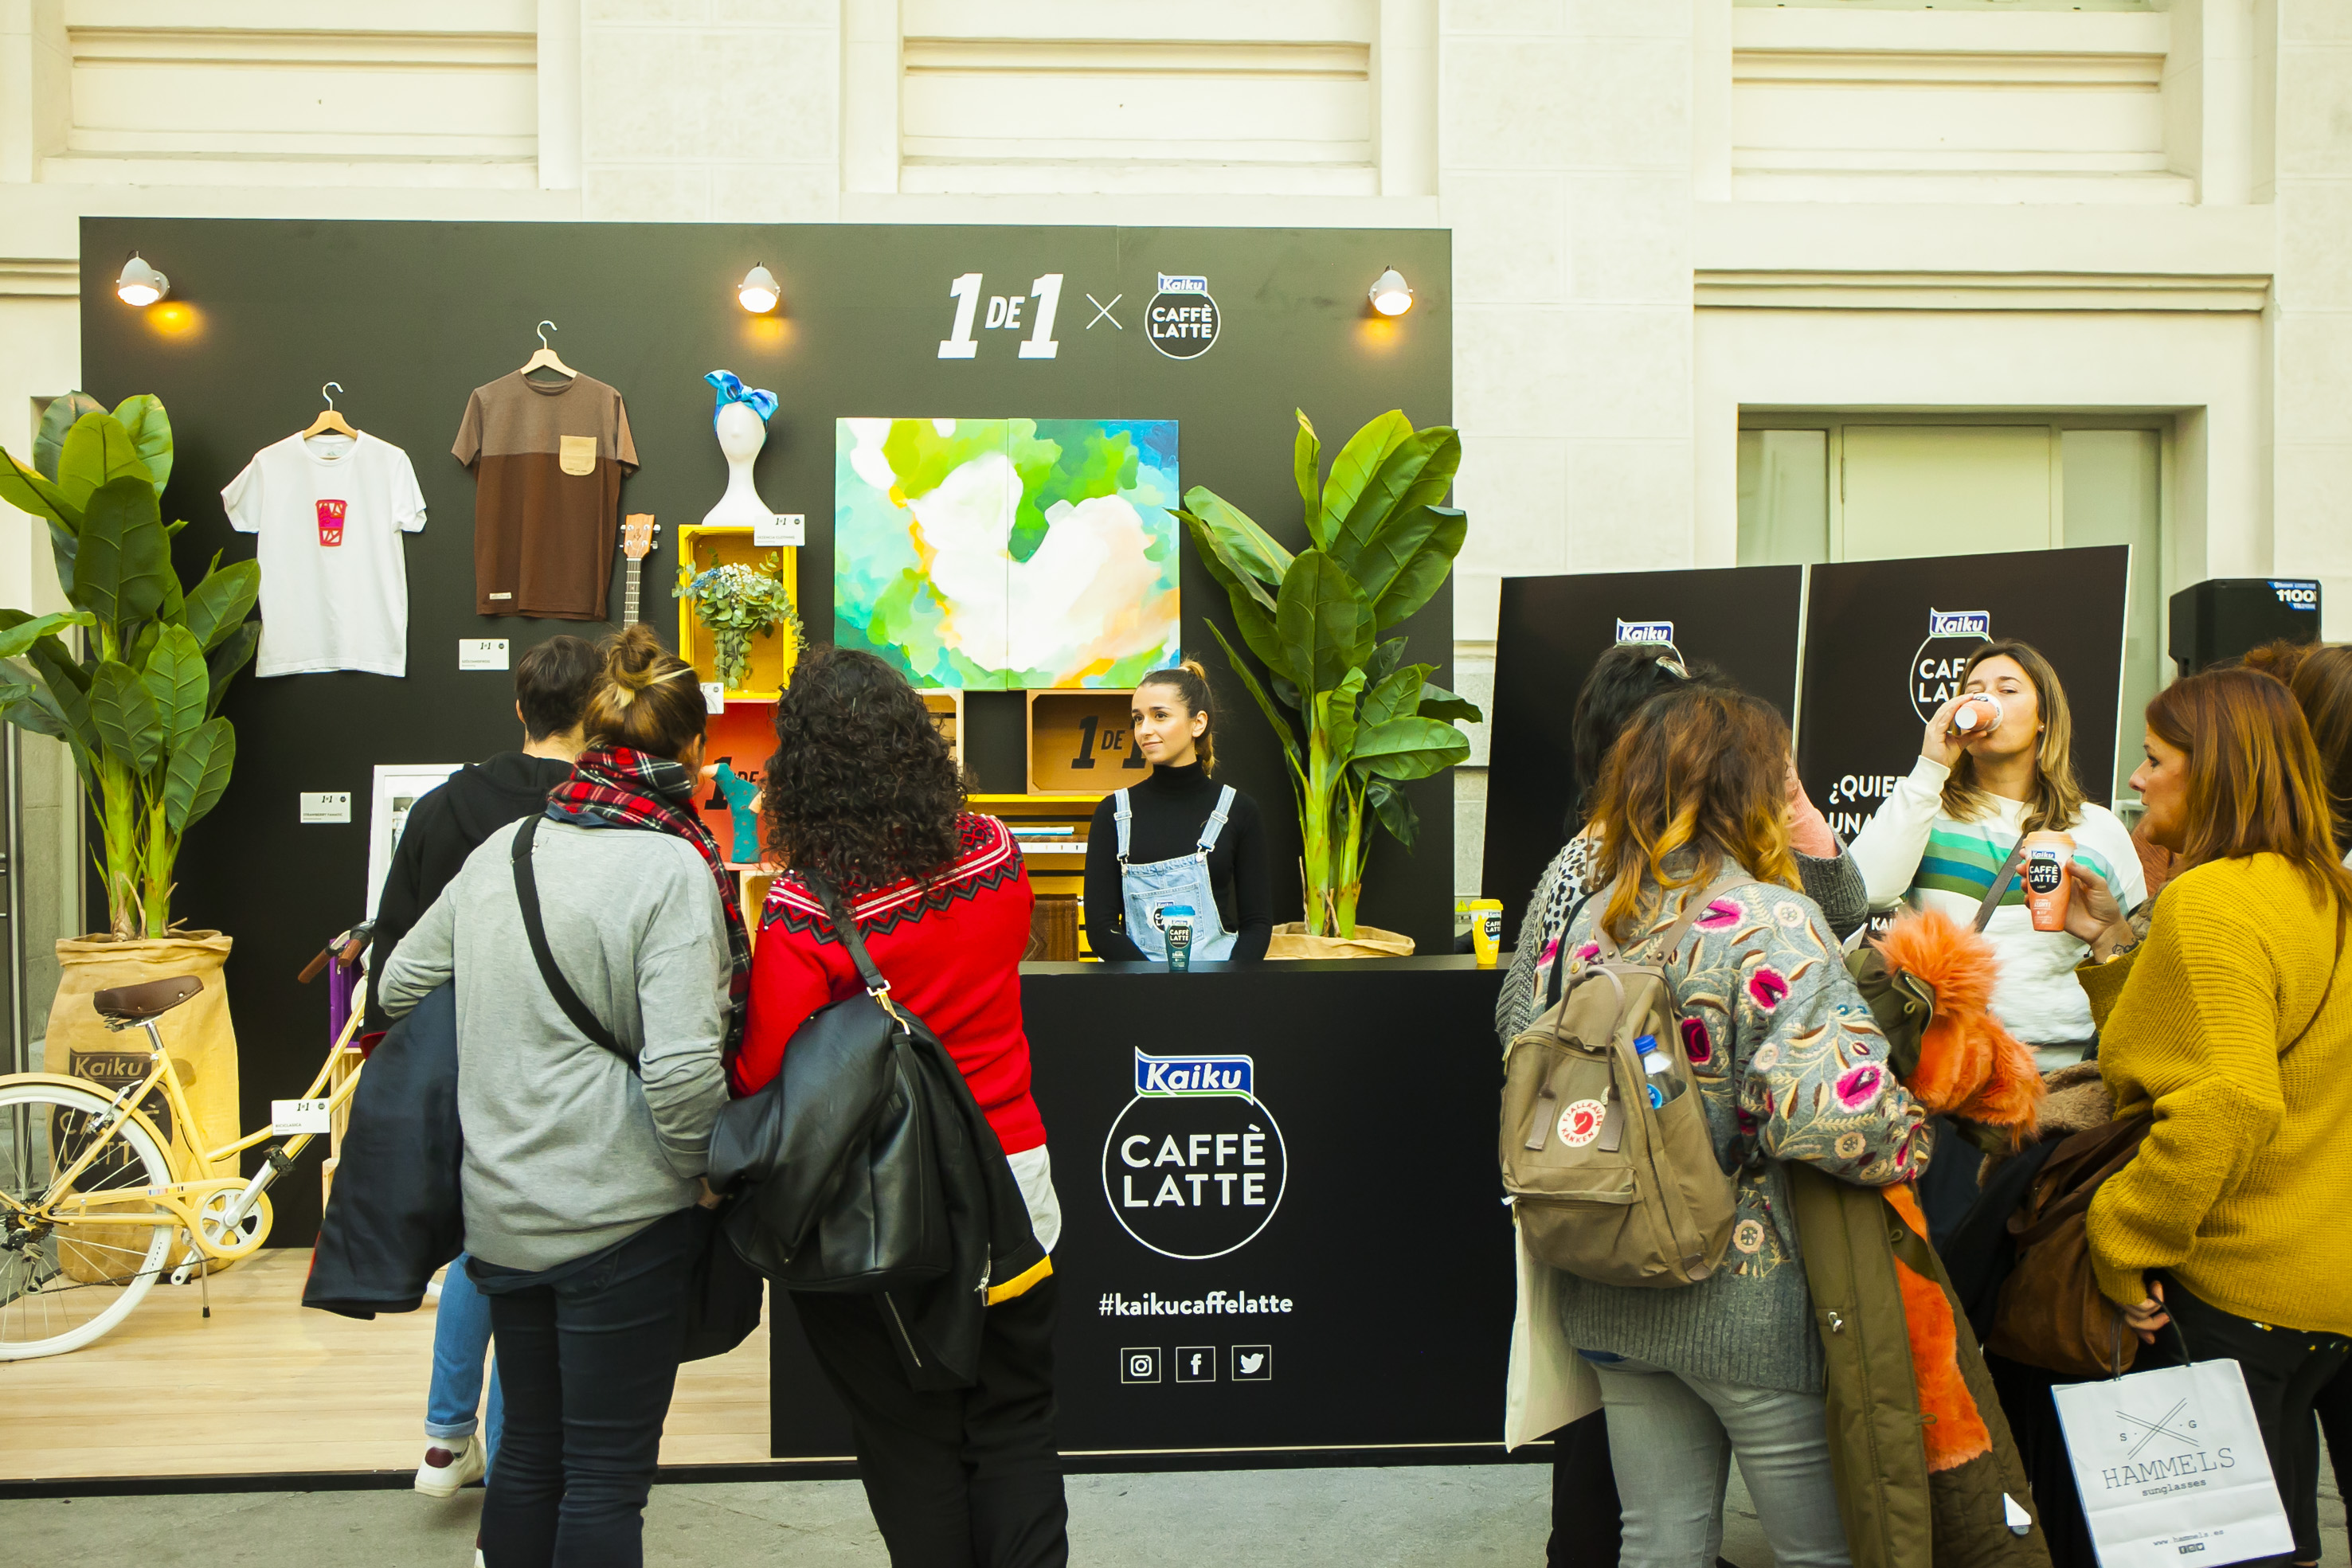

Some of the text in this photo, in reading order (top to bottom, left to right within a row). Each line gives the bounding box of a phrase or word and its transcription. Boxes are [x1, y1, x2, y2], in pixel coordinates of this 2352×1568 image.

[1162, 279, 1203, 291] Kaiku
[1152, 304, 1212, 323] CAFFÈ
[1153, 323, 1212, 338] LATTE
[1621, 626, 1668, 641] Kaiku
[1935, 616, 1983, 635] Kaiku
[1920, 658, 1972, 679] CAF
[1830, 775, 1908, 804] ¿QUIE
[2029, 865, 2058, 874] CAFFÈ
[2029, 874, 2058, 883] LATTE
[74, 1057, 143, 1081] Kaiku
[1146, 1062, 1242, 1096] Kaiku
[1121, 1124, 1266, 1167] CAFFÈ
[1124, 1173, 1266, 1207] LATTE
[1098, 1291, 1293, 1316] #kaikucaffelatte
[2102, 1447, 2235, 1489] HAMMELS
[2142, 1479, 2207, 1496] sunglasses
